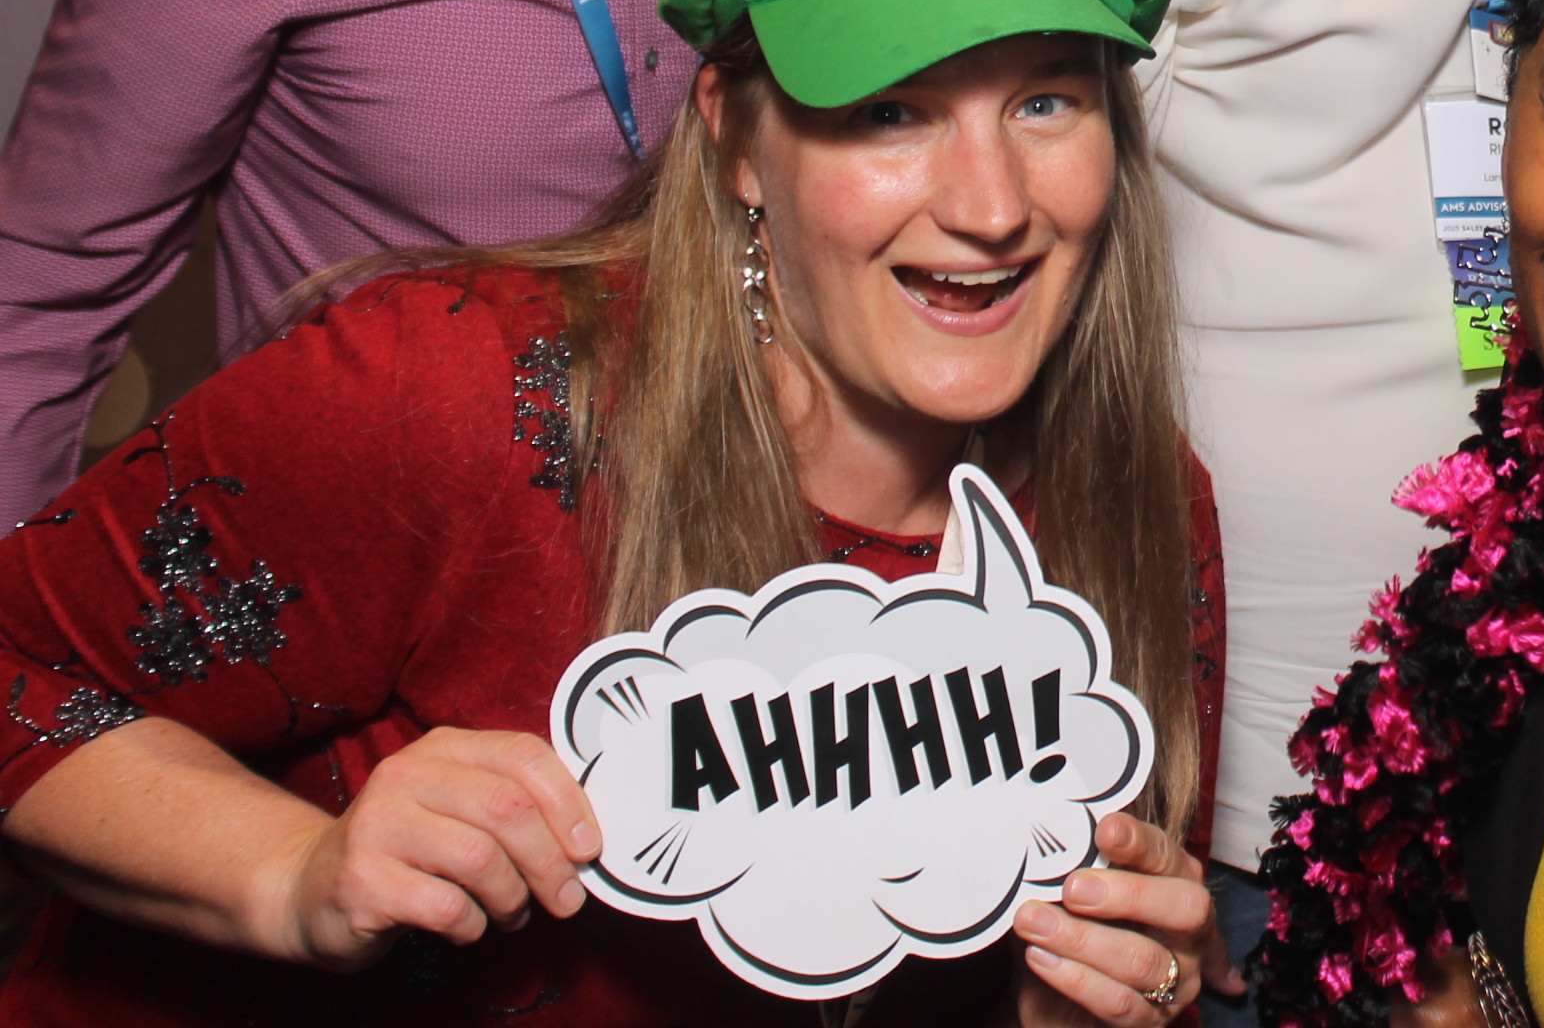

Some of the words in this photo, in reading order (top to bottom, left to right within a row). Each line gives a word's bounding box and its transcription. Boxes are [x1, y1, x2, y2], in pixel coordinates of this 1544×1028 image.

[1440, 202, 1465, 213] AMS
[1467, 200, 1508, 213] ADVISO
[1461, 224, 1483, 232] SALES
[671, 665, 1067, 812] AHHHH!
